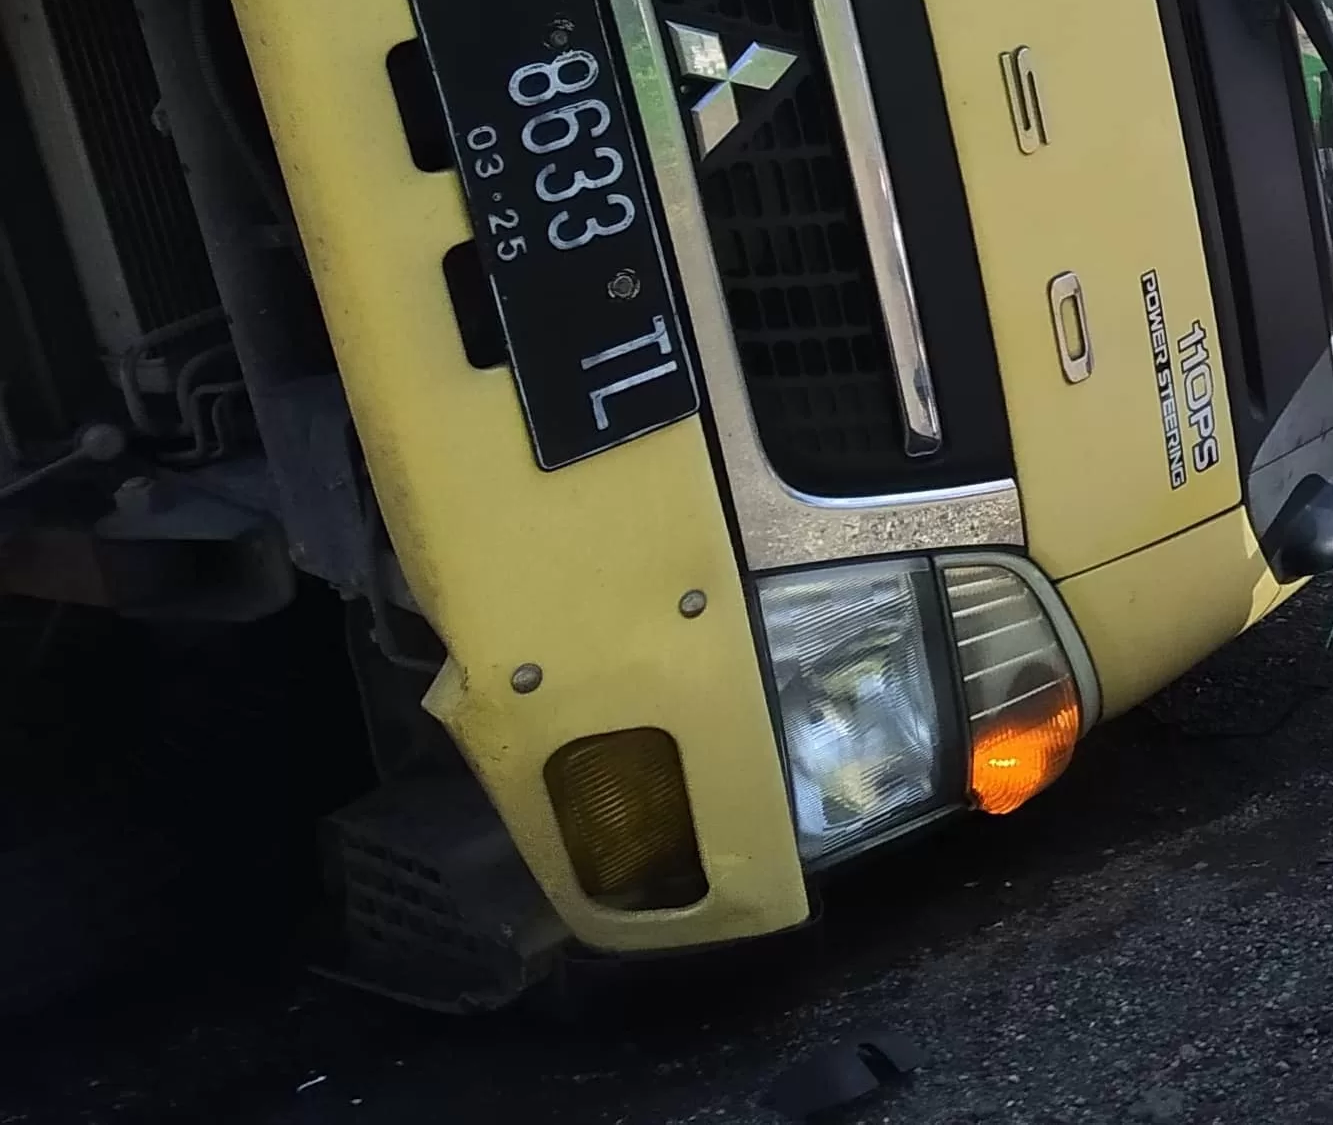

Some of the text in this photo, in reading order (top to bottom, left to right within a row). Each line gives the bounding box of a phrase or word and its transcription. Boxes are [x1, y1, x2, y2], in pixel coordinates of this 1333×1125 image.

[507, 48, 636, 250] 8633
[580, 315, 678, 430] TL
[1140, 268, 1187, 490] POWER STEERING
[1177, 320, 1221, 474] 110PS
